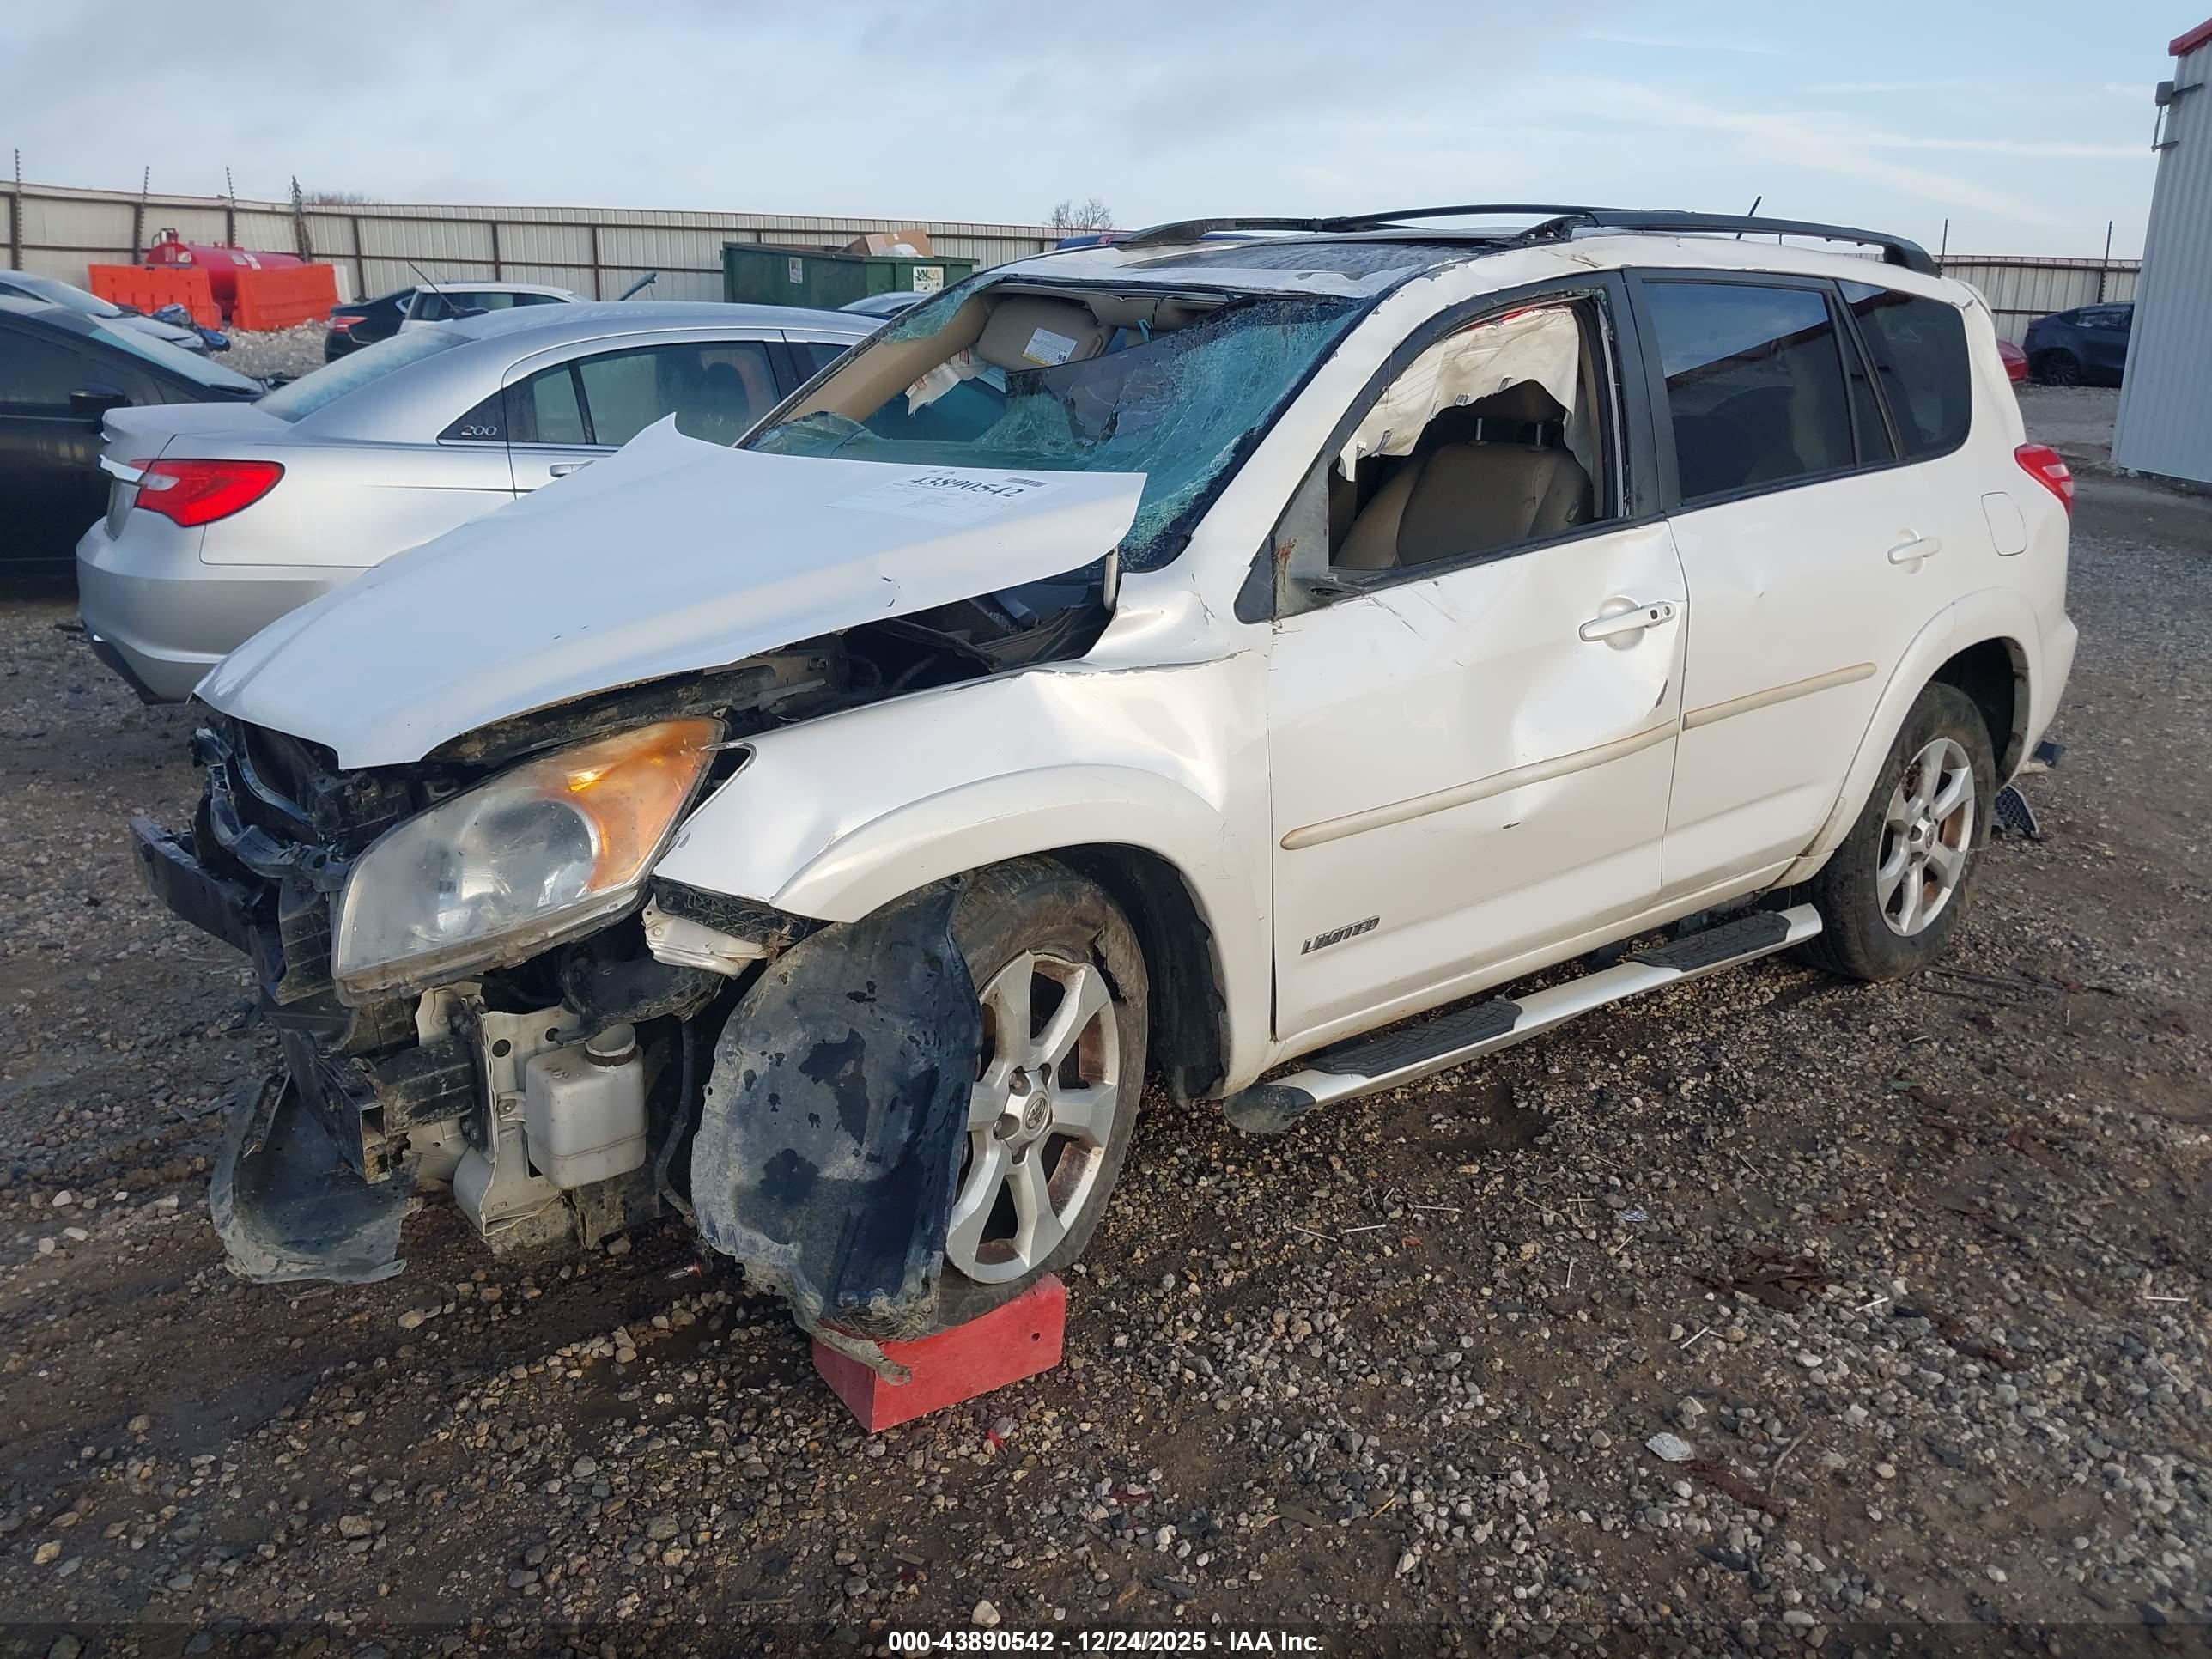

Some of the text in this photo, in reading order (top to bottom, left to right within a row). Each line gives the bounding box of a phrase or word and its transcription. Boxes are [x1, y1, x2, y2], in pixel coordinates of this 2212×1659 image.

[461, 425, 498, 436] 200
[909, 477, 1024, 497] 43890542
[1300, 915, 1381, 955] LIMITED
